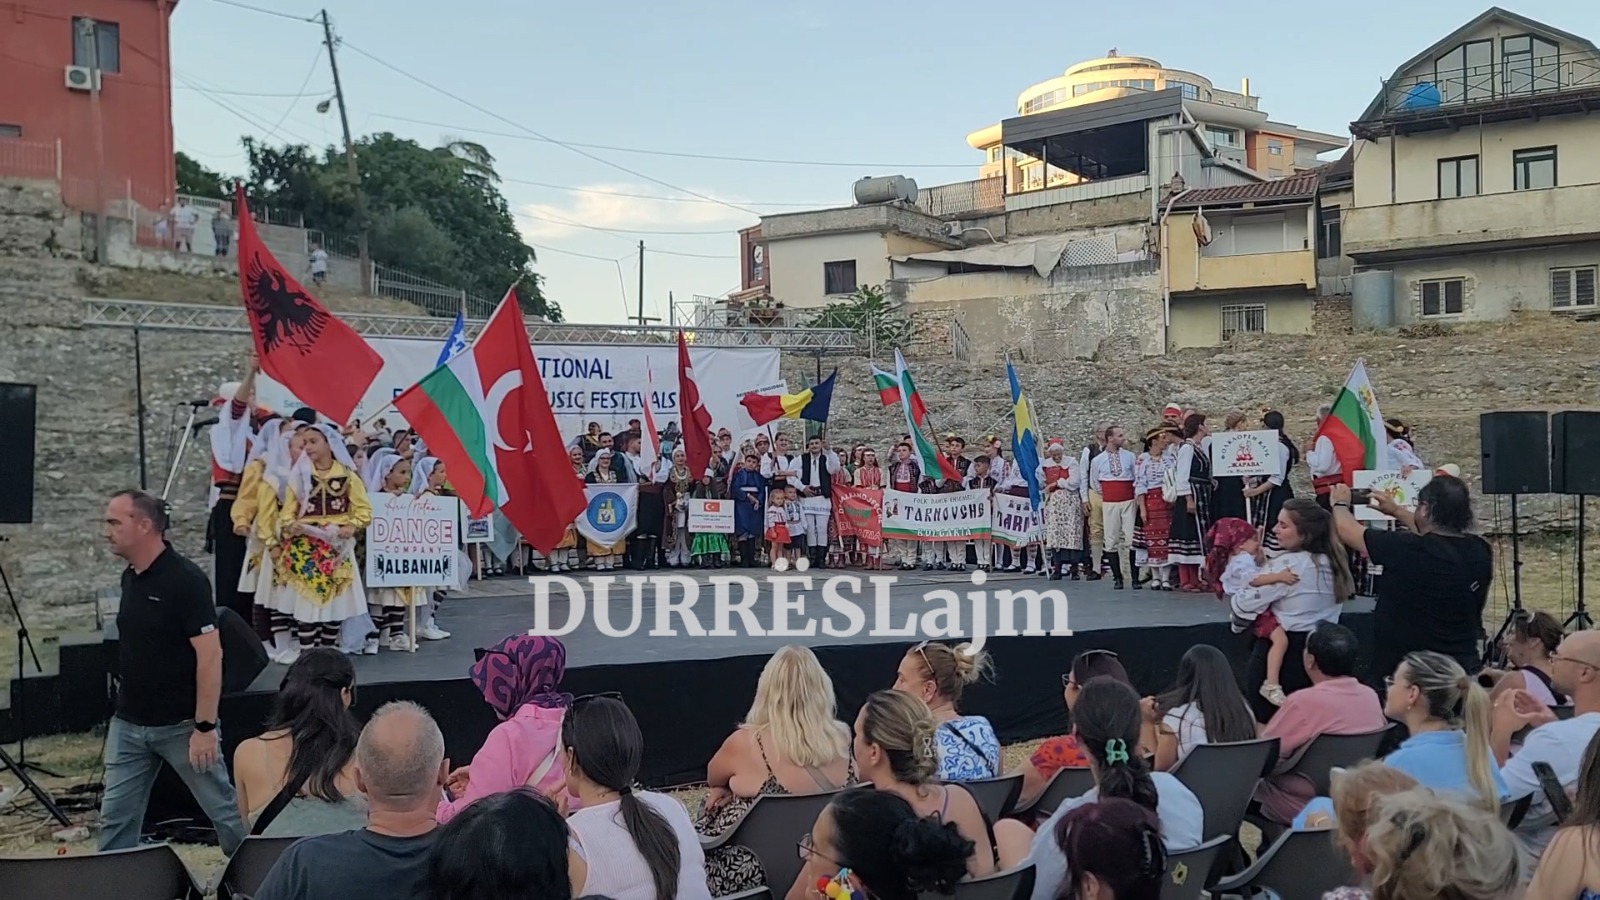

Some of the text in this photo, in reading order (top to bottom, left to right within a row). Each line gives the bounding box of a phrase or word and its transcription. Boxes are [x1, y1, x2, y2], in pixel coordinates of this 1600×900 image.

[538, 358, 612, 379] TIONAL
[549, 391, 676, 409] USIC FESTIVALS
[373, 517, 452, 544] DANCE
[917, 527, 972, 537] BULGARIA
[385, 559, 442, 574] ALBANIA
